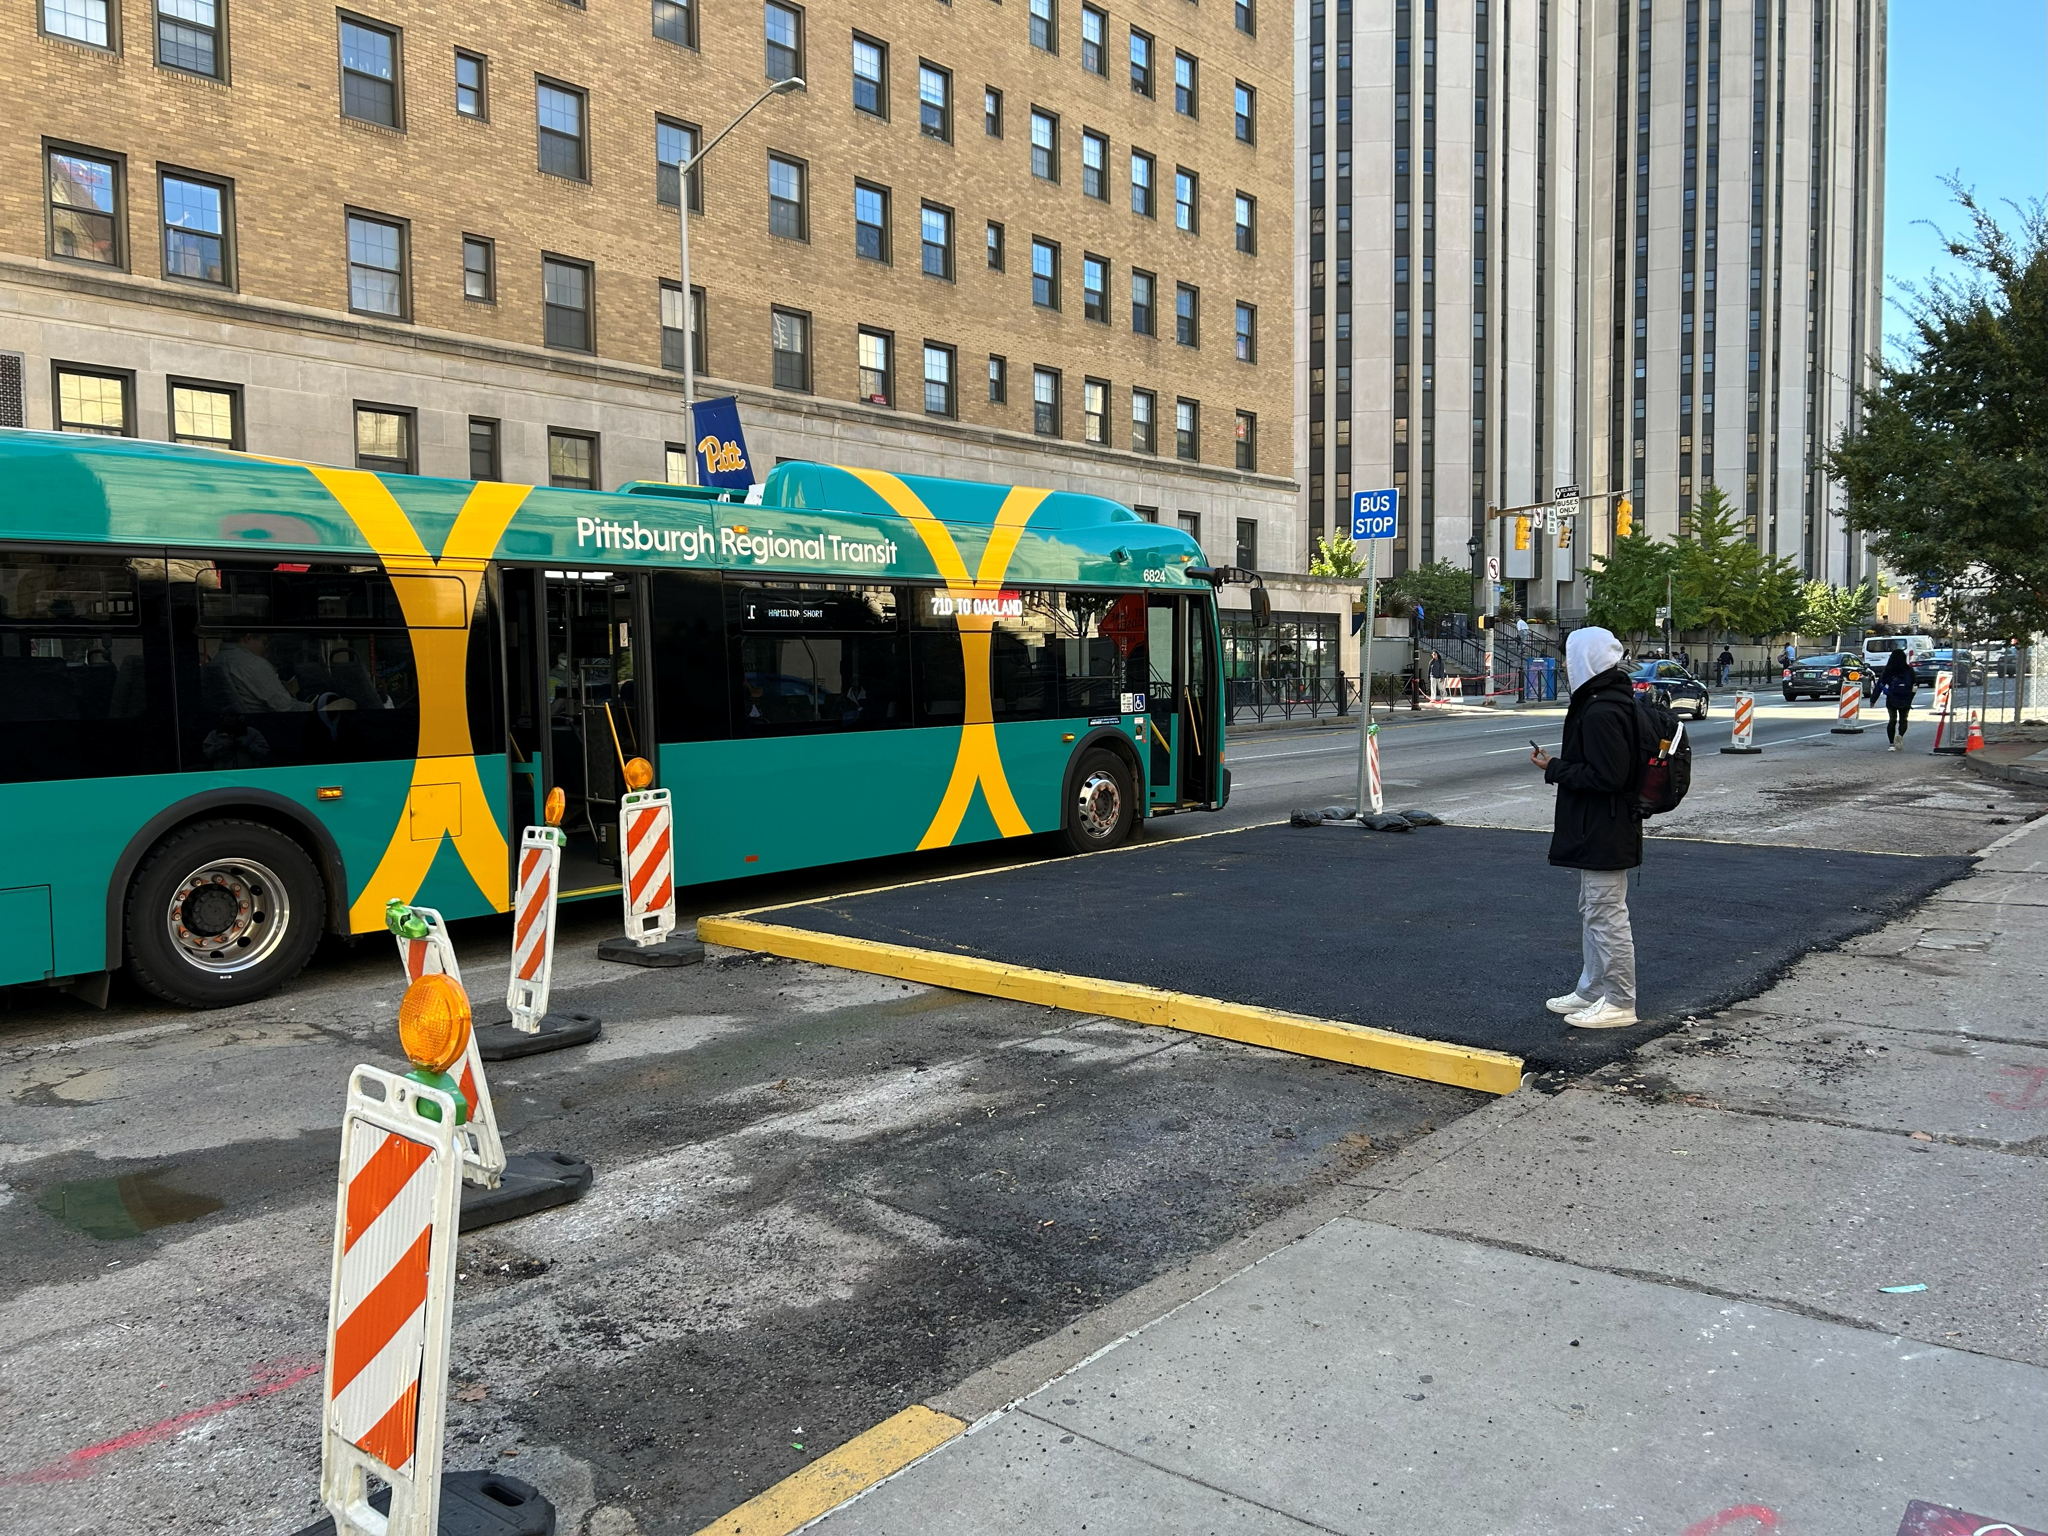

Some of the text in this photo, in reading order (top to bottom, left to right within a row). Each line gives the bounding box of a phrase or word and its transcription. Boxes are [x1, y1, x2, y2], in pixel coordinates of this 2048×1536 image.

[698, 435, 746, 474] Pitt
[1360, 495, 1390, 513] BUS
[1355, 516, 1394, 534] STOP
[577, 517, 898, 565] Pittsburgh Regional Transit
[1143, 569, 1166, 583] 6824
[803, 609, 824, 619] SHORT
[931, 597, 1023, 617] 71D TO OAKLAND
